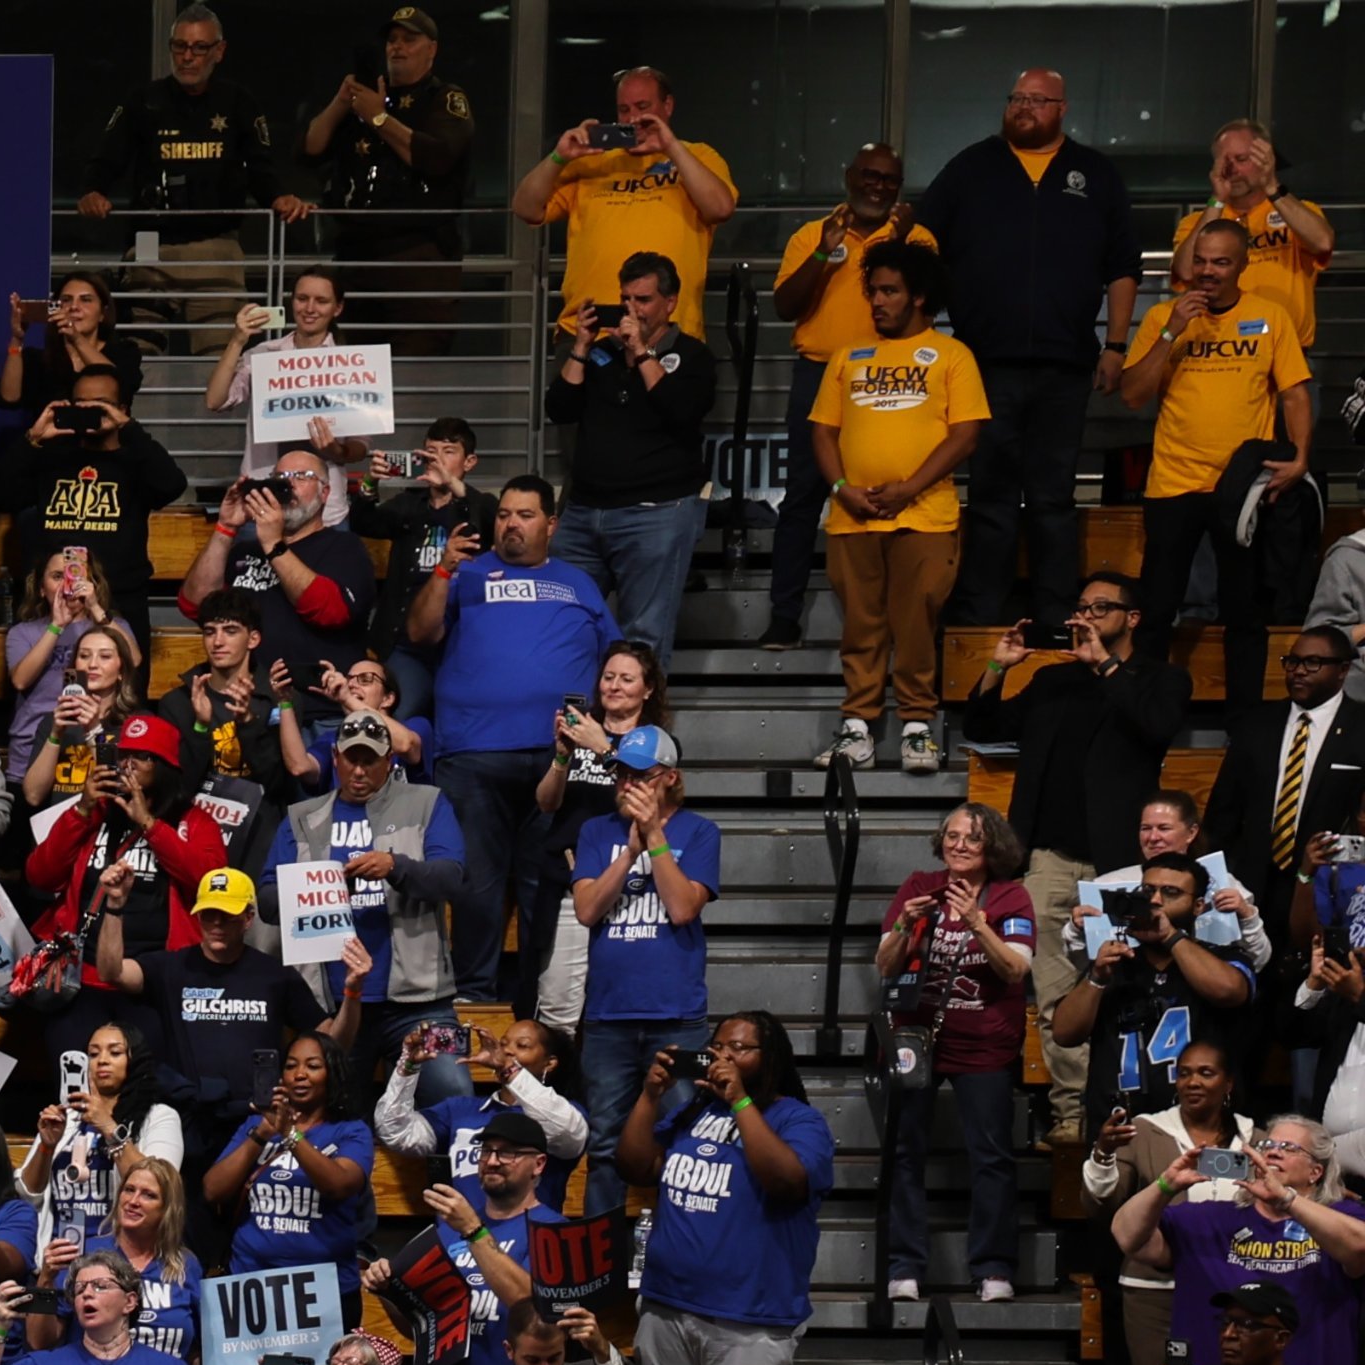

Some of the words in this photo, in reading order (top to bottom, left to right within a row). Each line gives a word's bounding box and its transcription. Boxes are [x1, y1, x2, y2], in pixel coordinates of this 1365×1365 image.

[160, 142, 224, 160] SHERIFF
[614, 172, 678, 194] UFCW
[1186, 340, 1259, 358] UFCW
[278, 352, 366, 374] MOVING
[269, 370, 378, 391] MICHIGAN
[865, 366, 929, 383] UFCW
[863, 381, 929, 396] OBAMA
[268, 390, 380, 413] FORWARD
[873, 398, 899, 409] 2012
[45, 520, 81, 531] MANLY
[83, 521, 118, 532] DEEDS
[489, 583, 533, 599] nea
[351, 893, 386, 907] SENATE
[626, 926, 658, 938] SENATE
[182, 999, 268, 1015] GILCHRIST
[197, 1013, 232, 1021] SECRETARY
[248, 1014, 268, 1022] STATE
[662, 1152, 733, 1197] ABDUL
[249, 1182, 323, 1219] ABDUL
[684, 1195, 719, 1213] SENATE
[272, 1216, 311, 1234] SENATE
[1231, 1238, 1273, 1259] UNION
[536, 1277, 597, 1300] NOVEMBER
[217, 1271, 322, 1340] VOTE
[402, 1242, 470, 1360] VOTE
[222, 1340, 240, 1353] BY
[241, 1334, 308, 1352] NOVEMBER
[310, 1332, 320, 1343] 3
